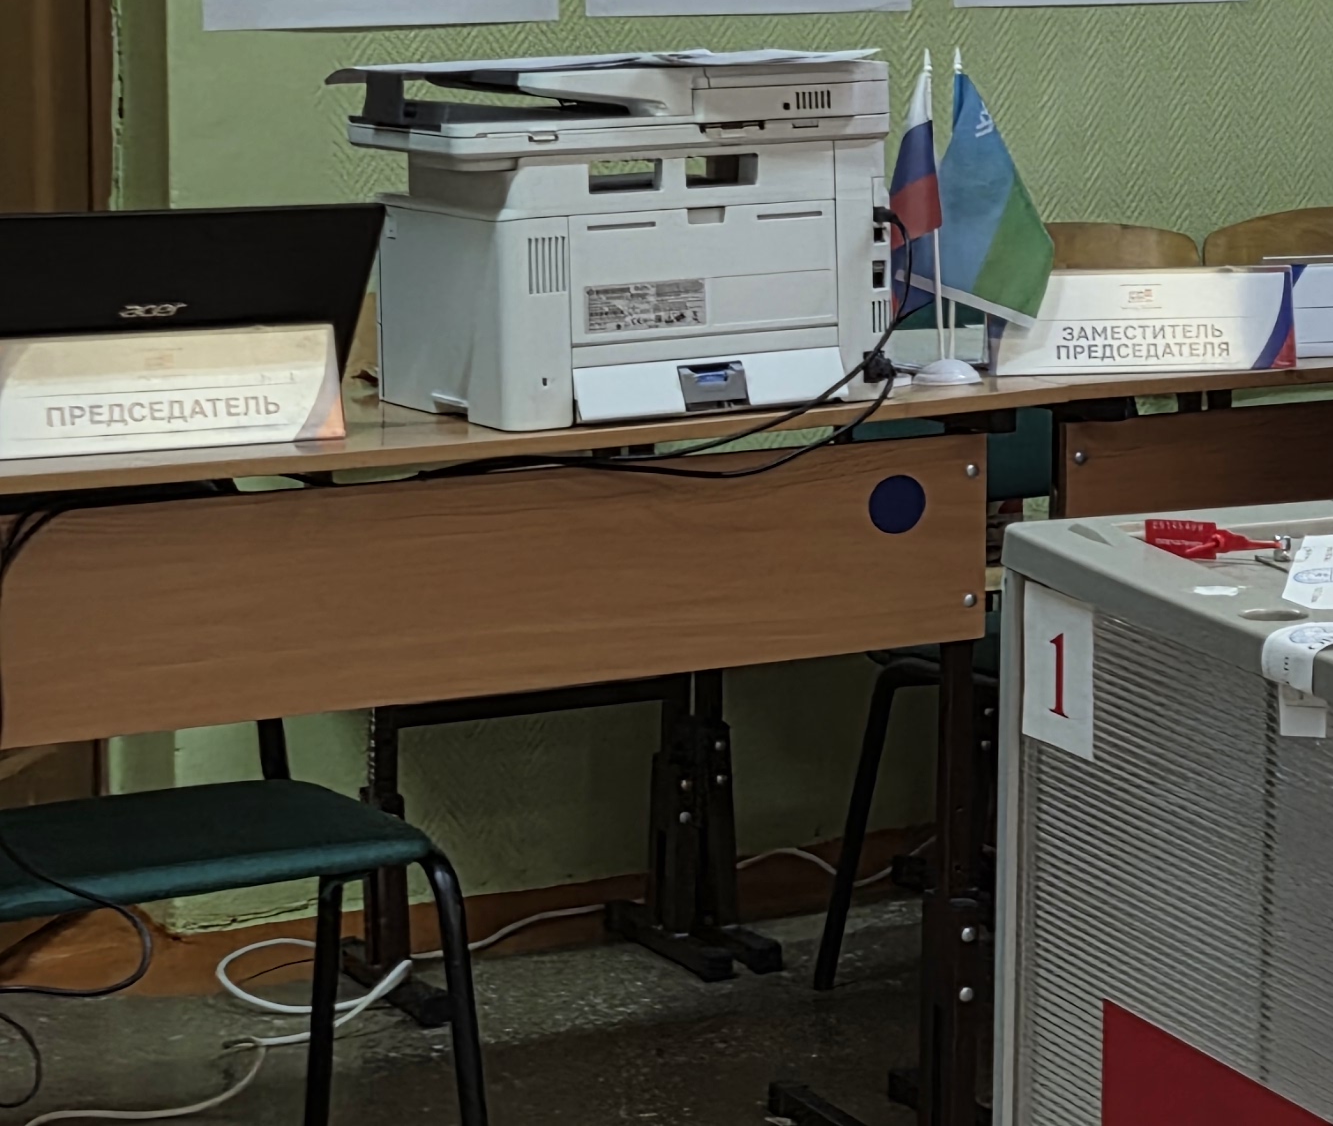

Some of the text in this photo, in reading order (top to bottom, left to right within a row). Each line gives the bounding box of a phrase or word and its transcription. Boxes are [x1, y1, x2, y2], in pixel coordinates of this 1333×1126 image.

[118, 302, 188, 318] acer
[1062, 323, 1224, 342] ЗАМЕСТИТЕЛЬ
[1055, 341, 1231, 362] ПРЕДСЕДАТЕЛЯ
[46, 394, 281, 428] ПРЕДСЕДАТЕЛЬ
[1047, 632, 1069, 719] 1
